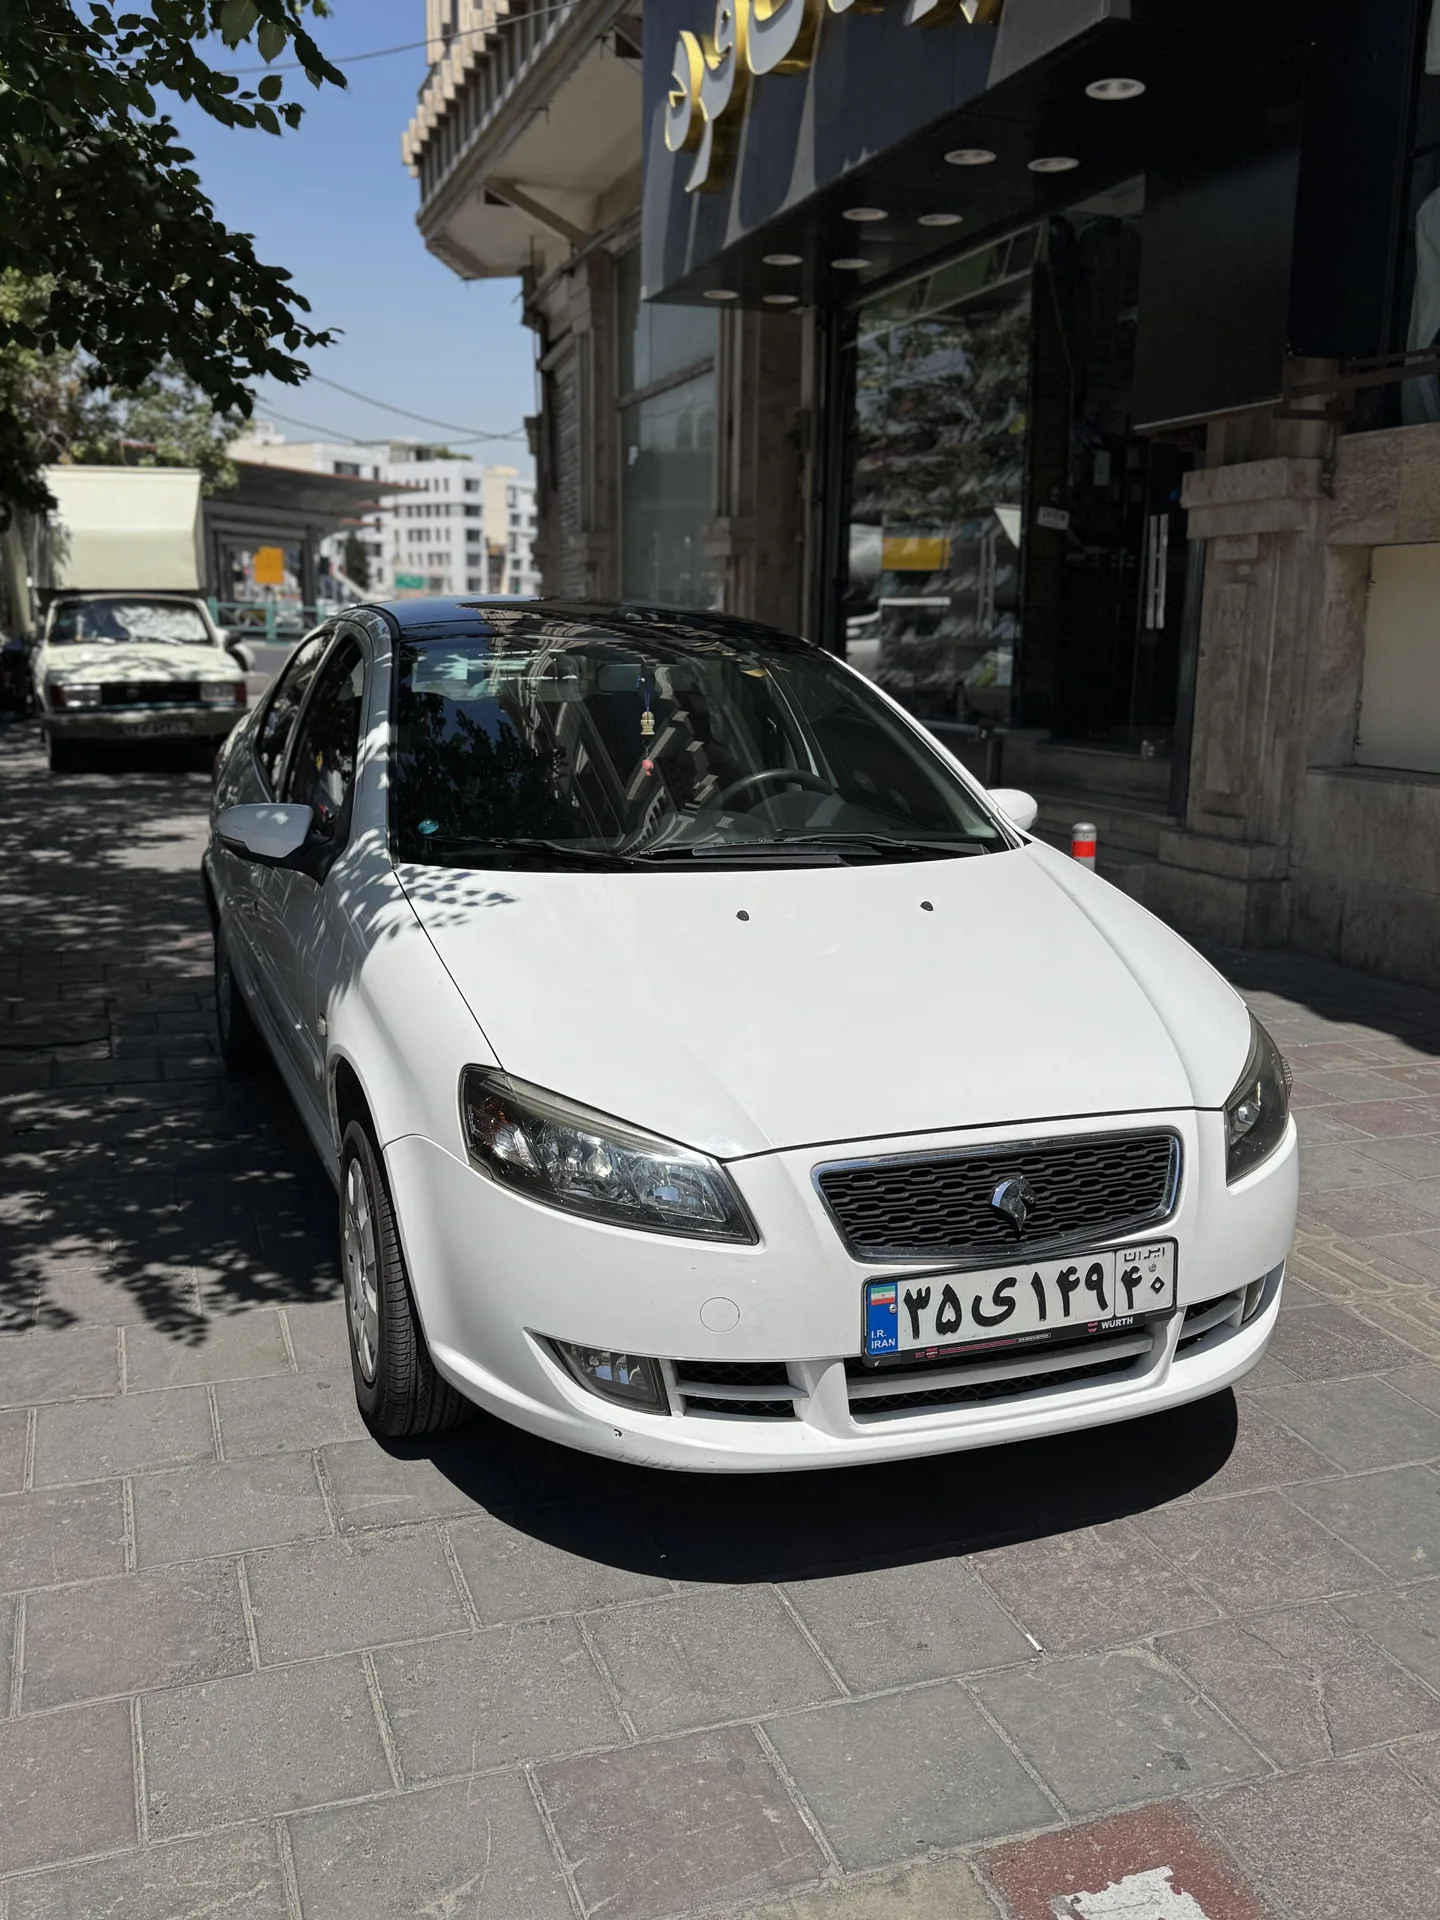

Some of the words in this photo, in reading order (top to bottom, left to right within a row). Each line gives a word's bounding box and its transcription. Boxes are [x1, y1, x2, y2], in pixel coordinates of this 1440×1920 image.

[1124, 1246, 1165, 1263] ایران
[871, 1329, 887, 1339] I.R.
[871, 1338, 896, 1349] IRAN
